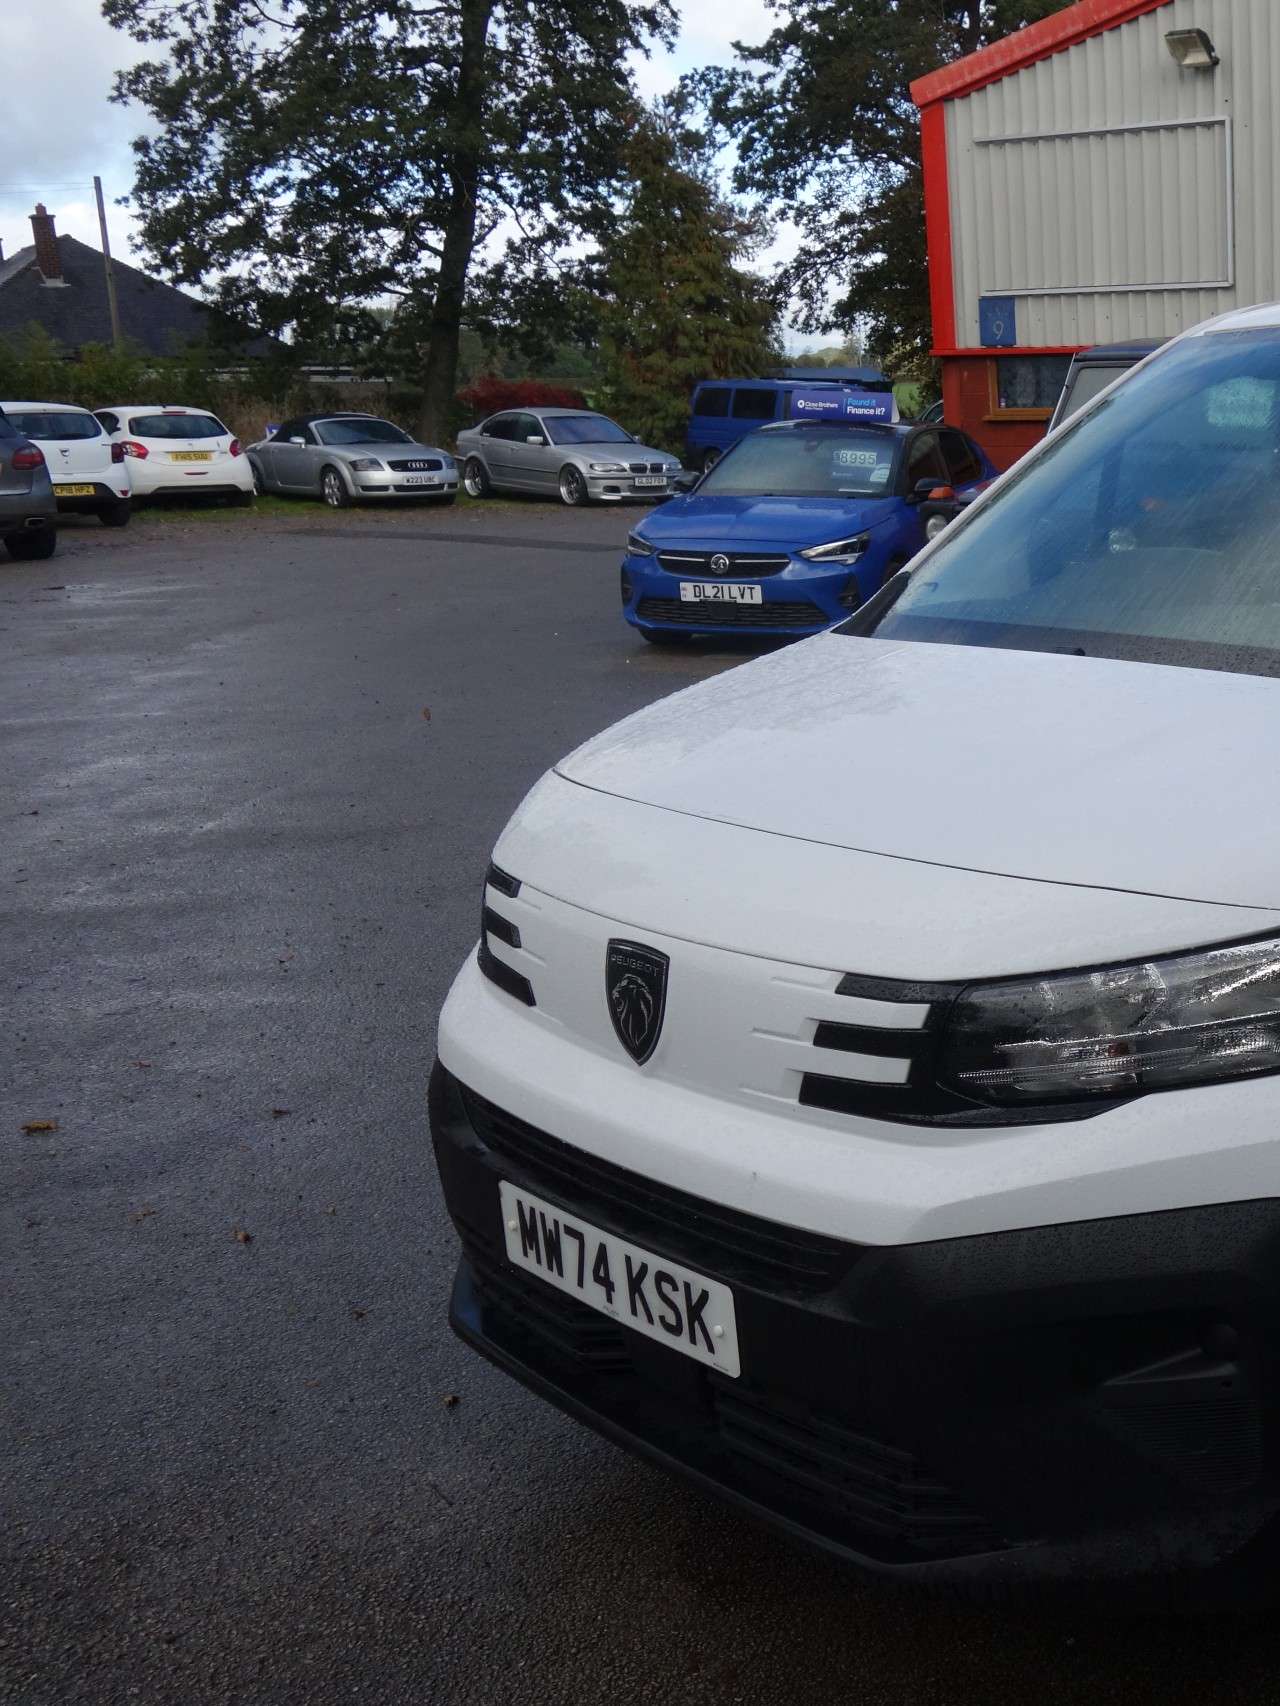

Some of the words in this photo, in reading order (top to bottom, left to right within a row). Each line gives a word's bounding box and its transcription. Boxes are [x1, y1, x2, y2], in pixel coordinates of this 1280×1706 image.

[847, 397, 870, 406] Found
[870, 398, 877, 407] it
[847, 406, 875, 415] Finance
[875, 407, 886, 416] it?
[693, 584, 724, 599] DL21
[729, 586, 755, 600] LVT
[610, 954, 660, 977] PEUGEOT
[516, 1199, 616, 1305] MW74
[625, 1253, 715, 1355] KSK
